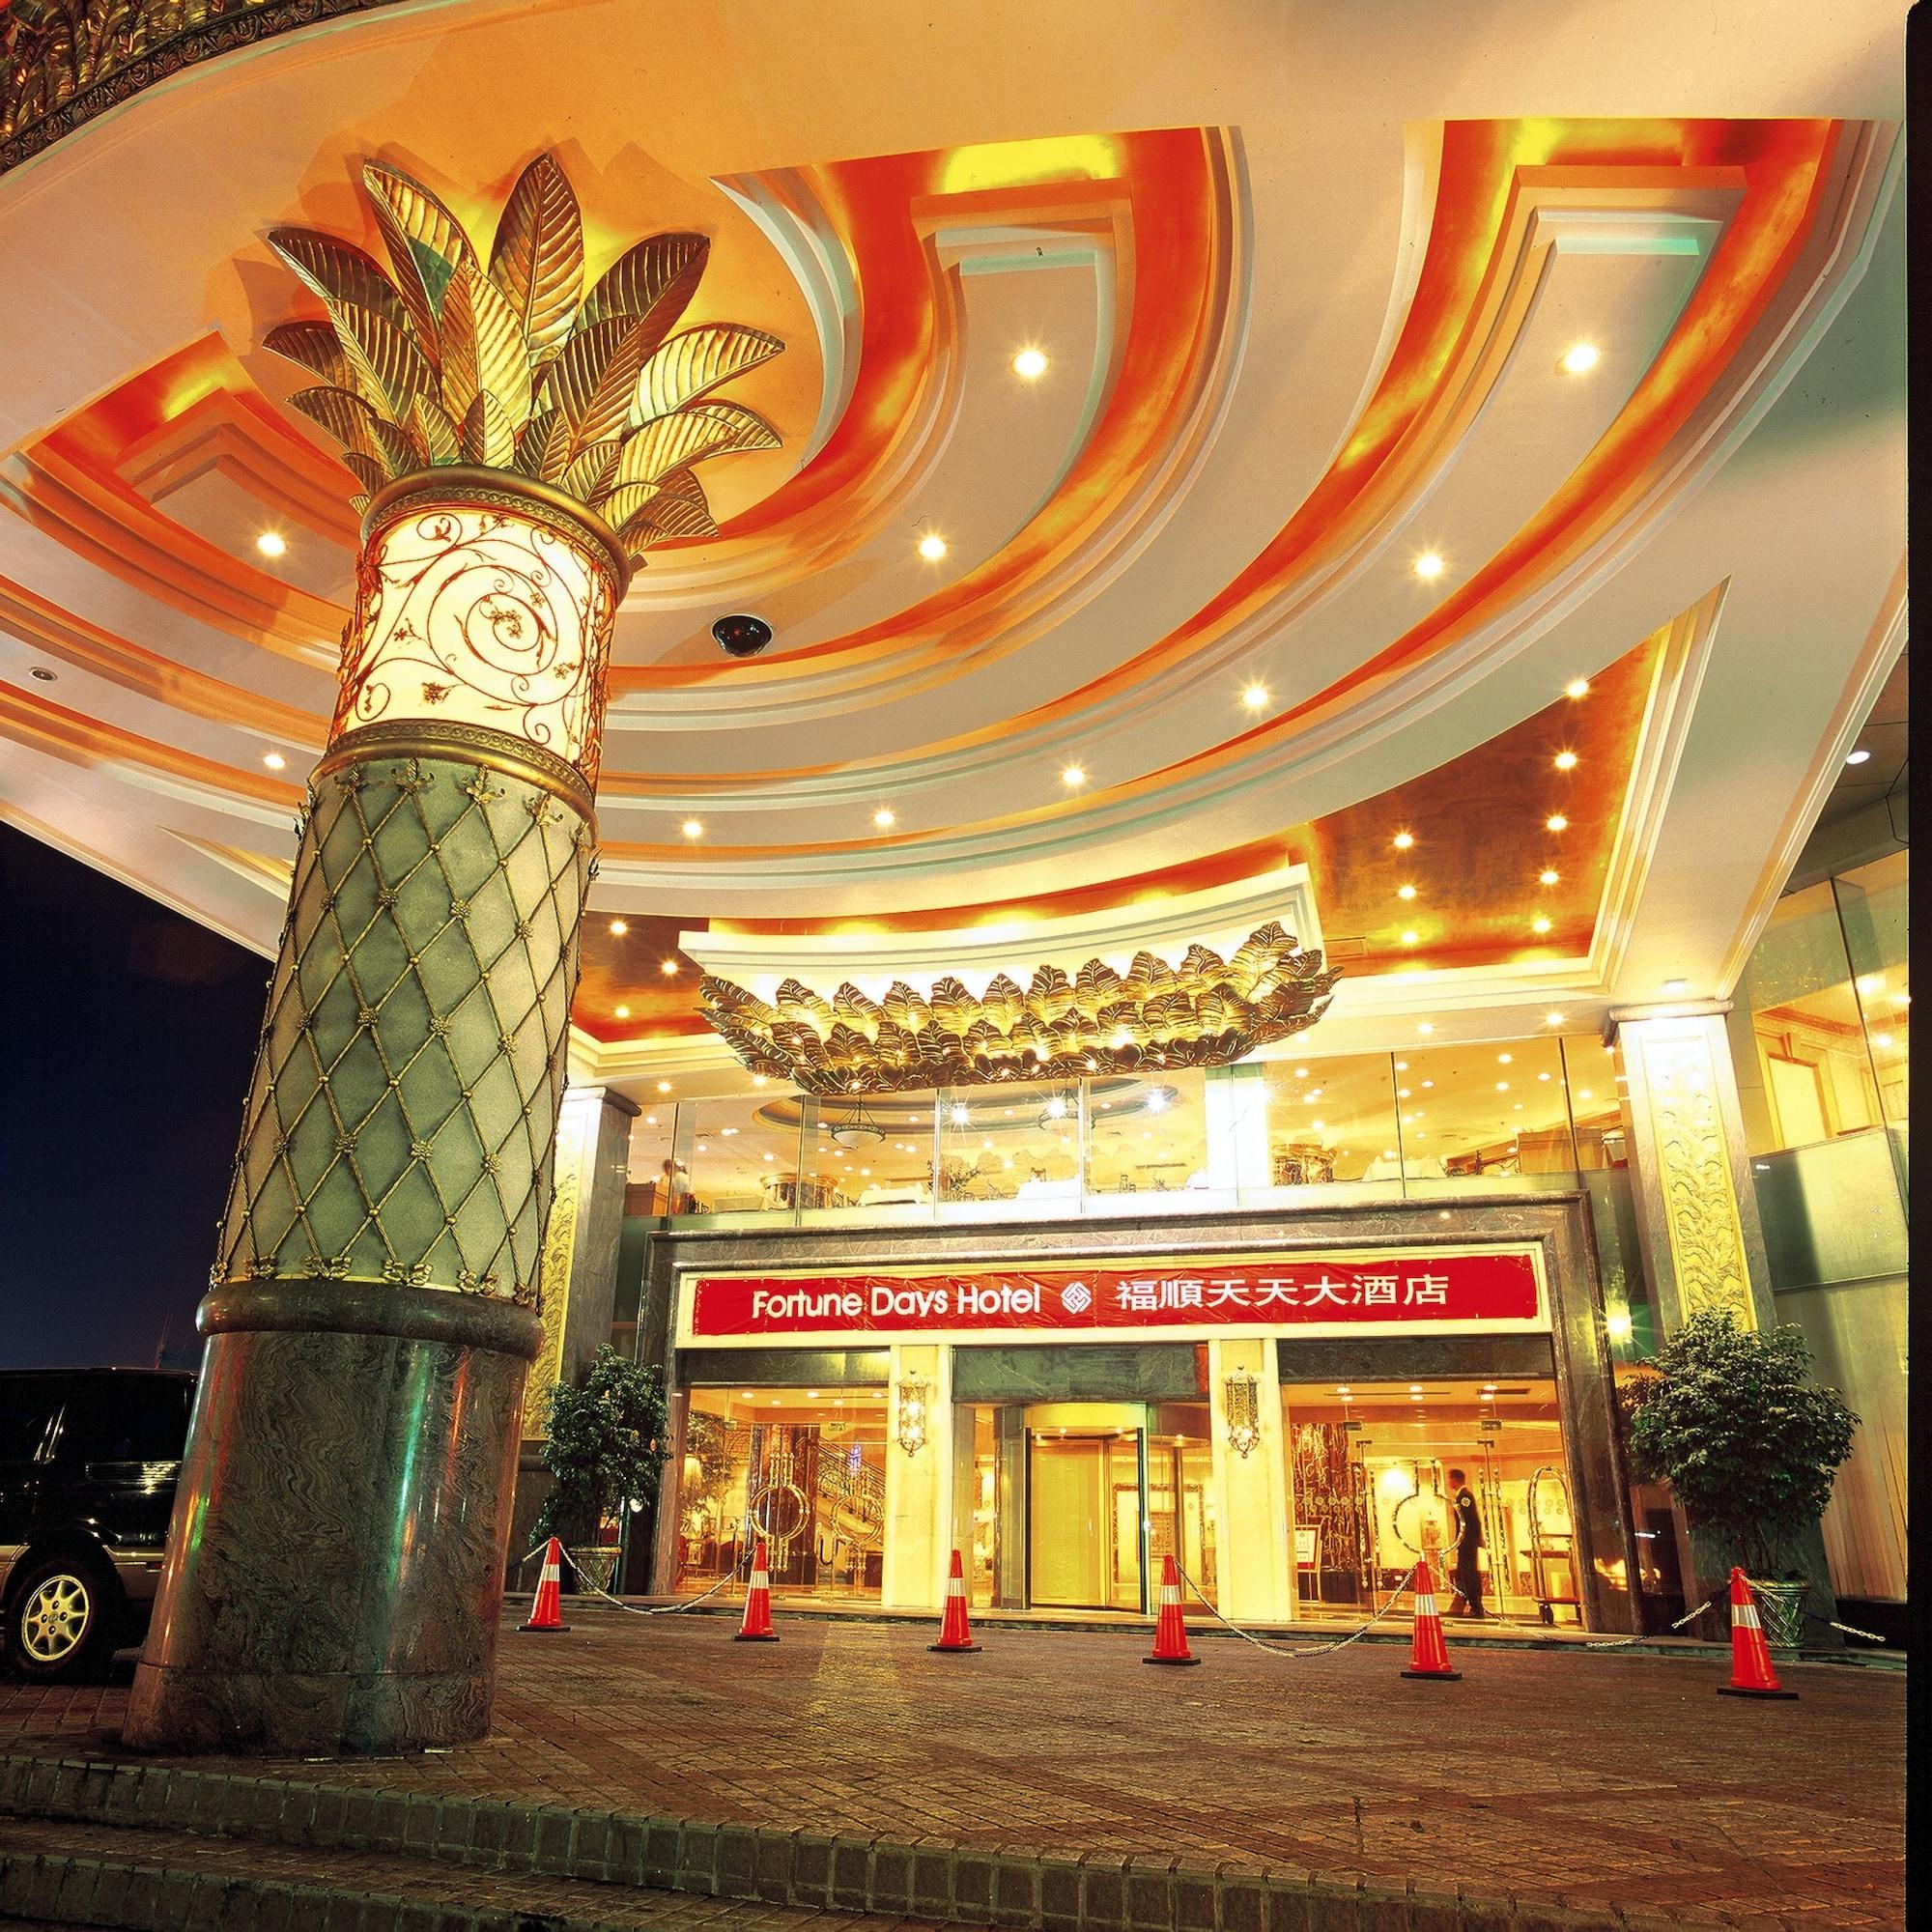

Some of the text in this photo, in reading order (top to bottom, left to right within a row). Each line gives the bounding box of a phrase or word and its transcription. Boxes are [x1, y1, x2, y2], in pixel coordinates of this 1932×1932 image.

[752, 1282, 1041, 1319] Fortune Days Hotel
[1115, 1274, 1449, 1311] 福順天天大酒店
